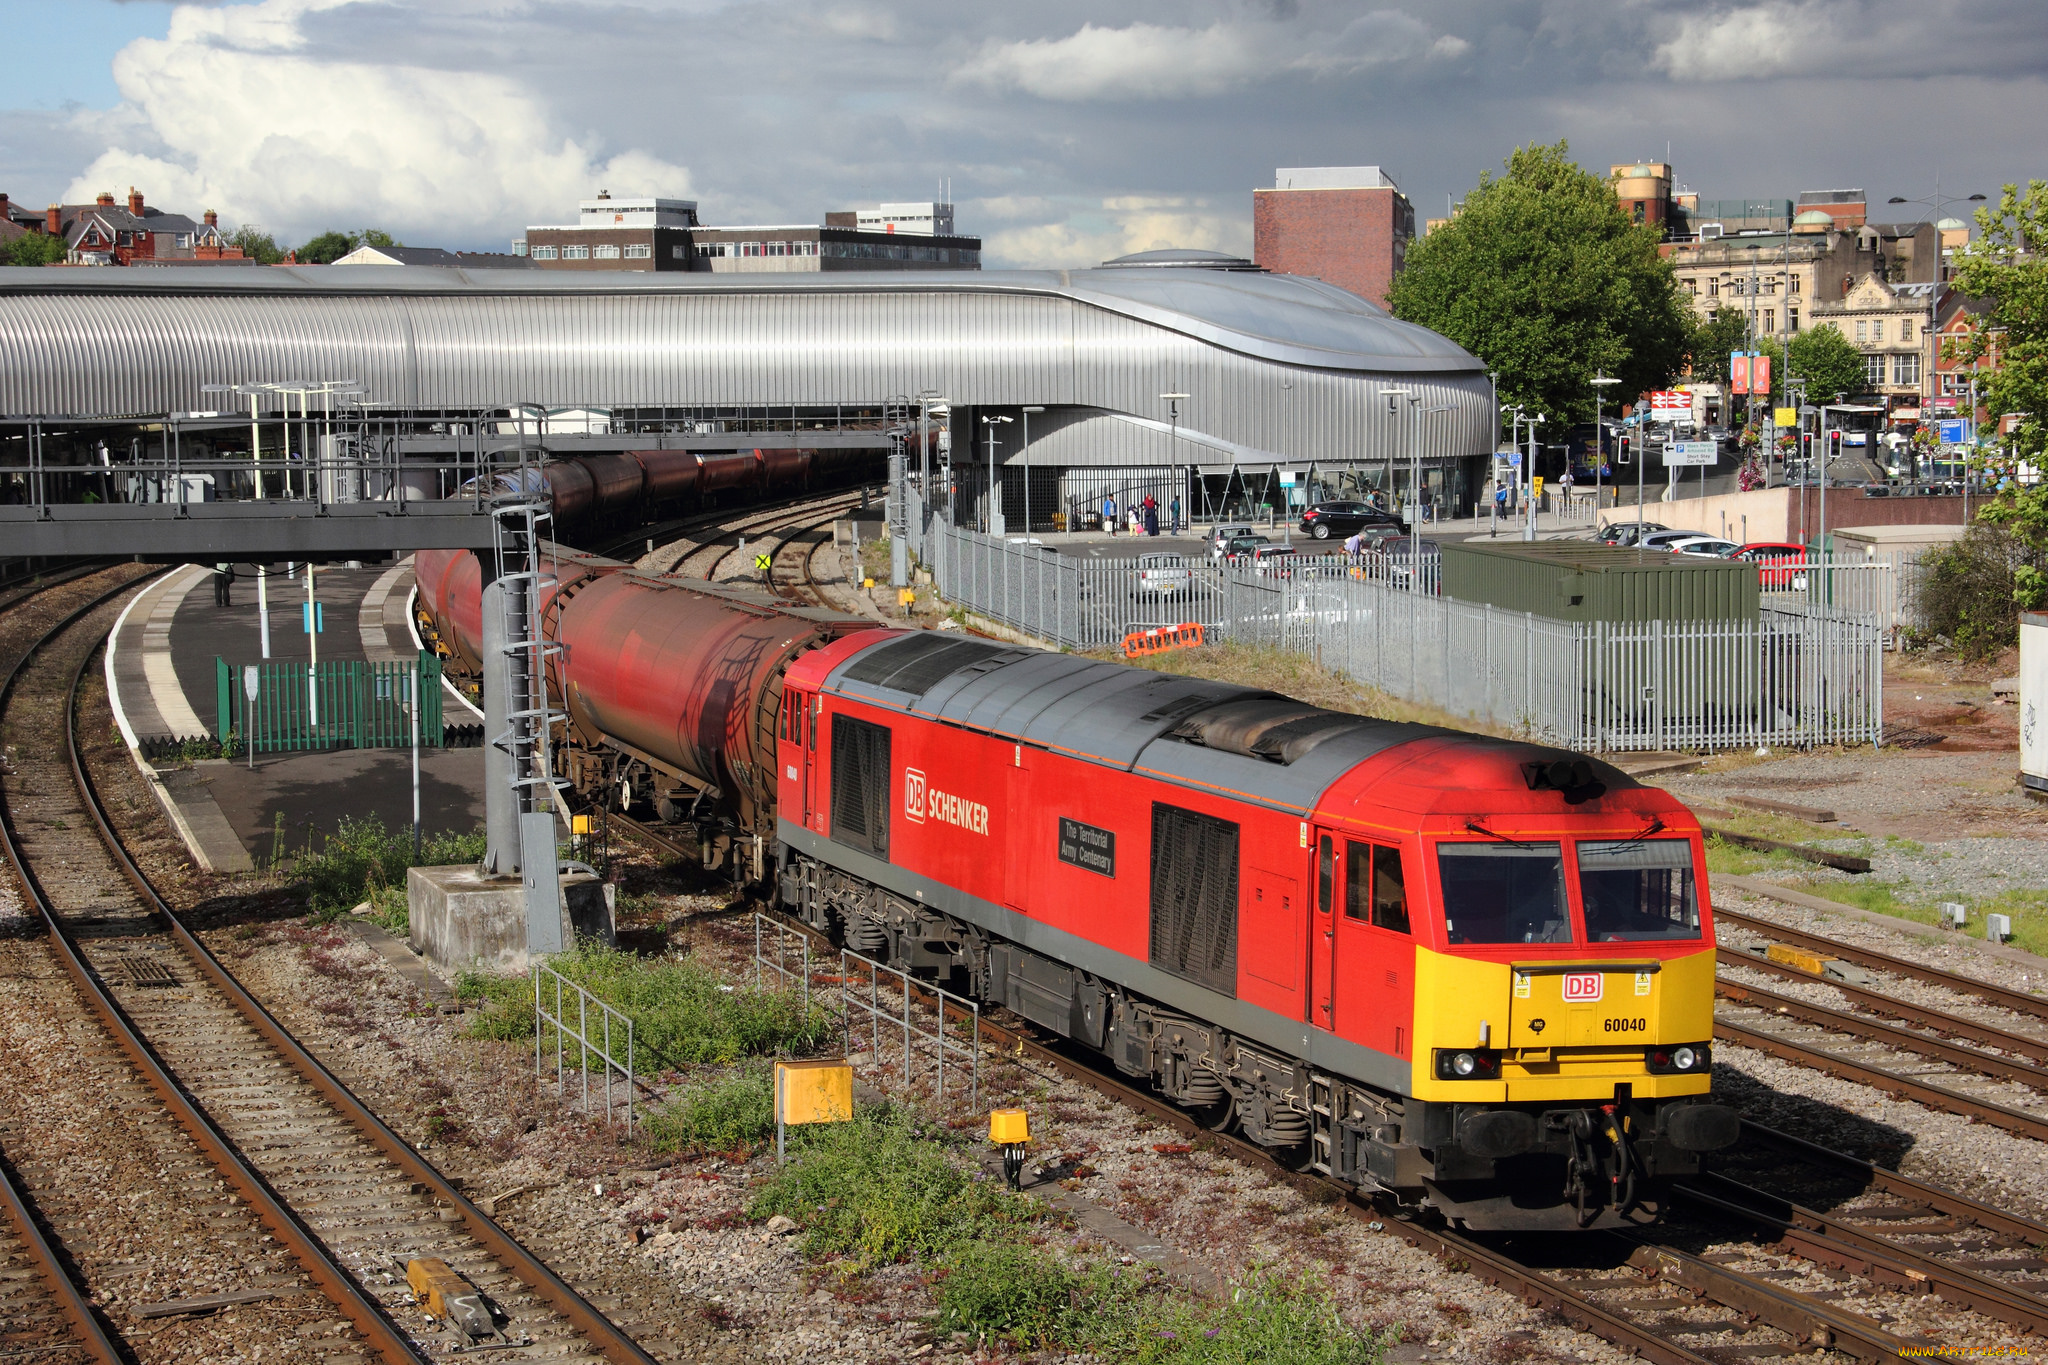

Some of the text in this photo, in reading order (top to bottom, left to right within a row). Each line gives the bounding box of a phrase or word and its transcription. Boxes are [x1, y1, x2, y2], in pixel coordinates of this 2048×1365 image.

[928, 788, 989, 836] SCHENKER
[1065, 821, 1108, 849] The Territorial
[1061, 840, 1111, 874] Army Centenary
[1569, 977, 1596, 995] DB
[1604, 1018, 1646, 1032] 60040
